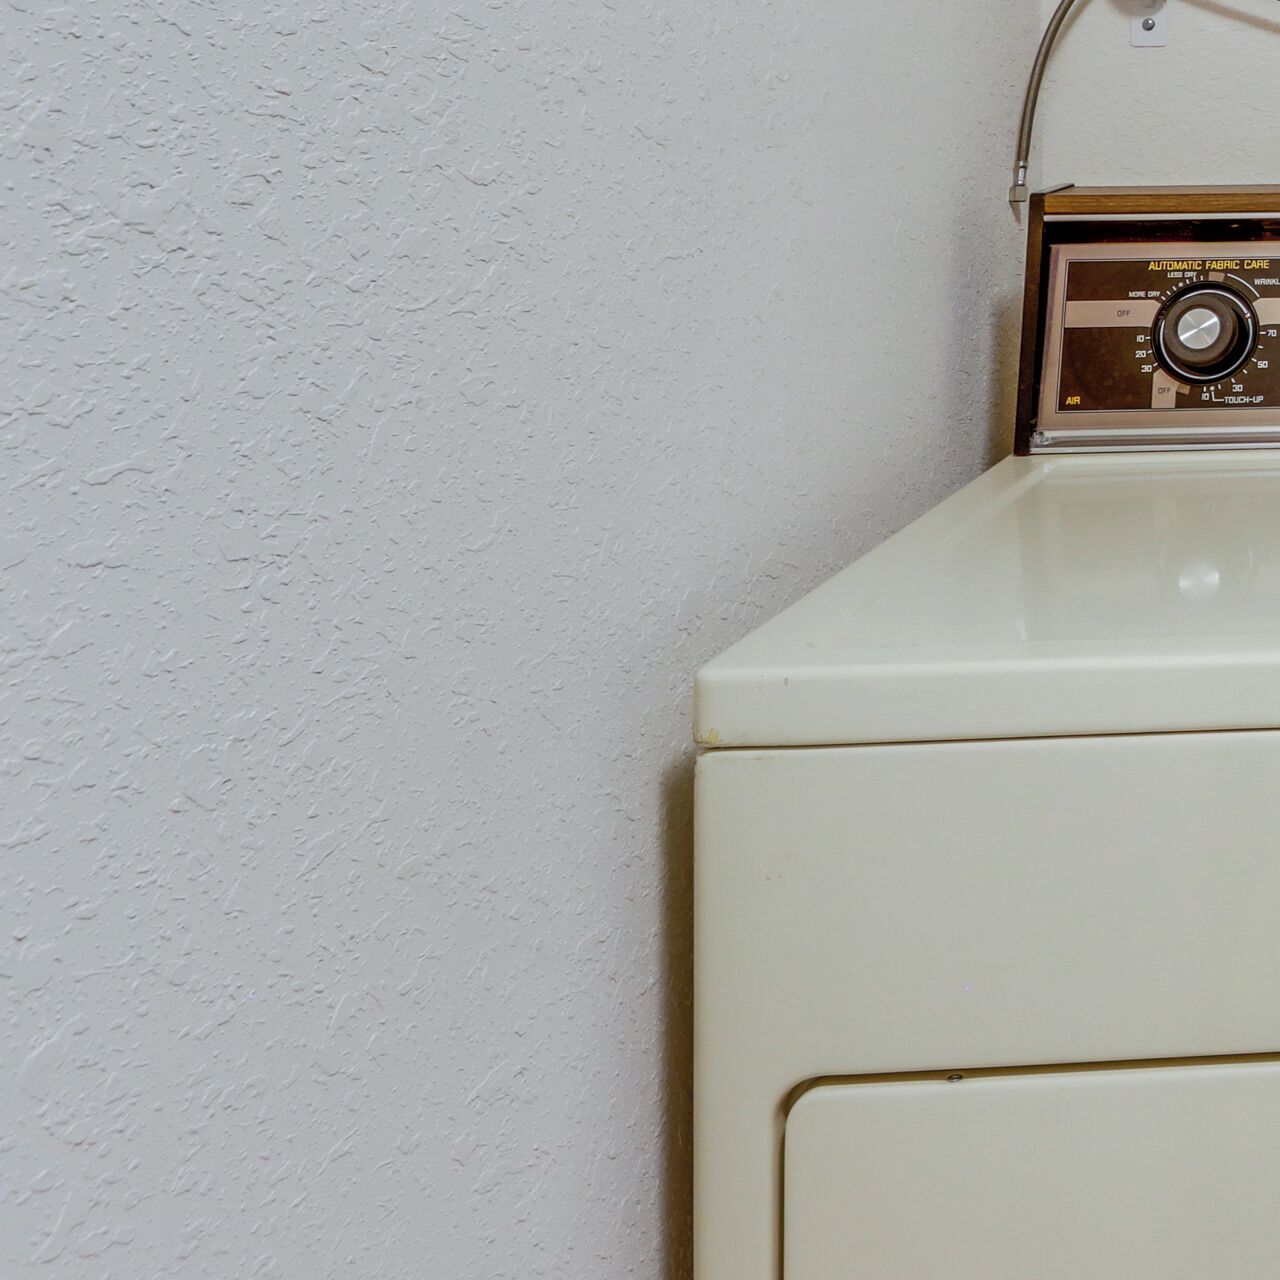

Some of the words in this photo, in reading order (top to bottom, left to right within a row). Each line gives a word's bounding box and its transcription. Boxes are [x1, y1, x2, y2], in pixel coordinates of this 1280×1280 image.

[1148, 260, 1202, 271] AUTOMATIC
[1205, 260, 1240, 270] FABRIC
[1244, 259, 1270, 269] CARE
[1116, 309, 1131, 317] OFF
[1267, 329, 1277, 337] 70
[1135, 350, 1147, 358] 20
[1232, 384, 1243, 392] 30
[1065, 396, 1081, 405] AIR
[1201, 393, 1210, 401] 10
[1224, 395, 1264, 404] TOUCH-UP
